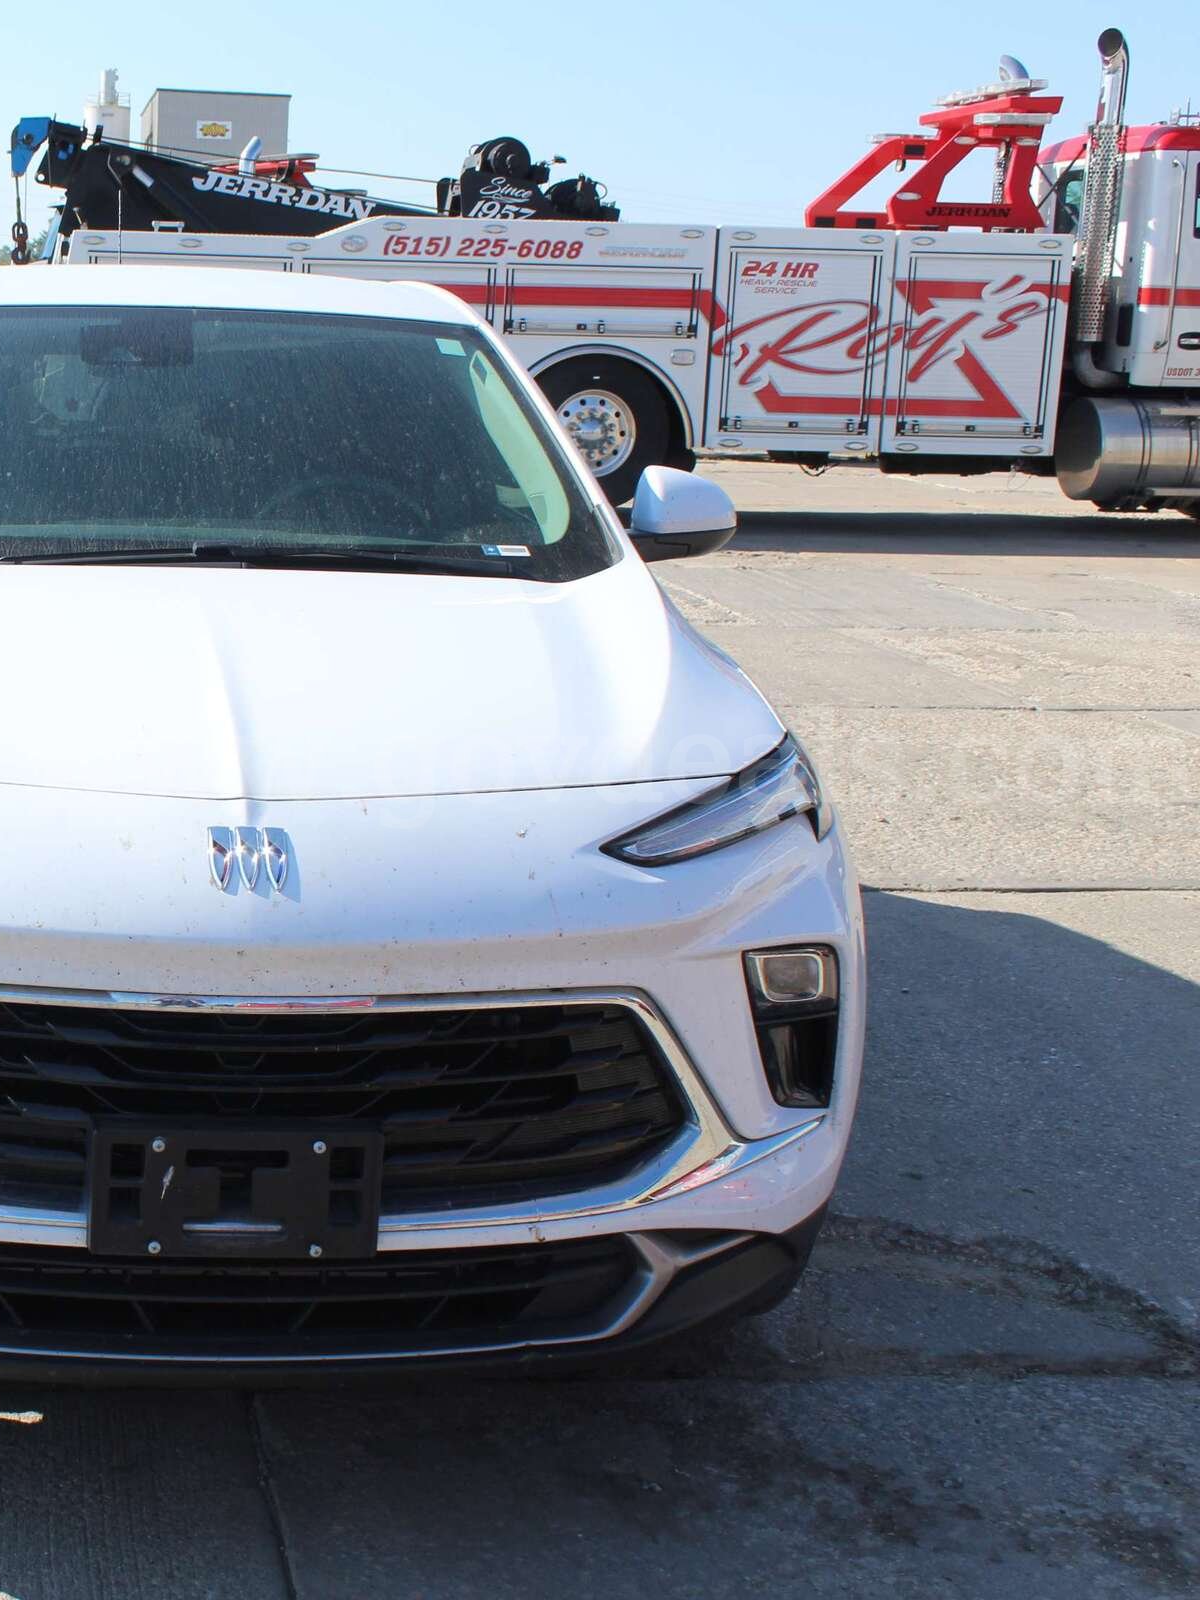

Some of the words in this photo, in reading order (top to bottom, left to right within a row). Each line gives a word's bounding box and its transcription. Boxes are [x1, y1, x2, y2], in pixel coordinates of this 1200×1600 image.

[192, 171, 377, 219] JERR-DAN
[480, 176, 533, 198] Since
[468, 200, 536, 219] 1957
[383, 235, 451, 257] (515)
[456, 238, 584, 259] 225-6088
[741, 261, 779, 277] 24
[782, 262, 820, 278] HR
[753, 286, 799, 295] SERVICE
[776, 280, 818, 288] RESCUE
[711, 274, 1049, 386] Roy's
